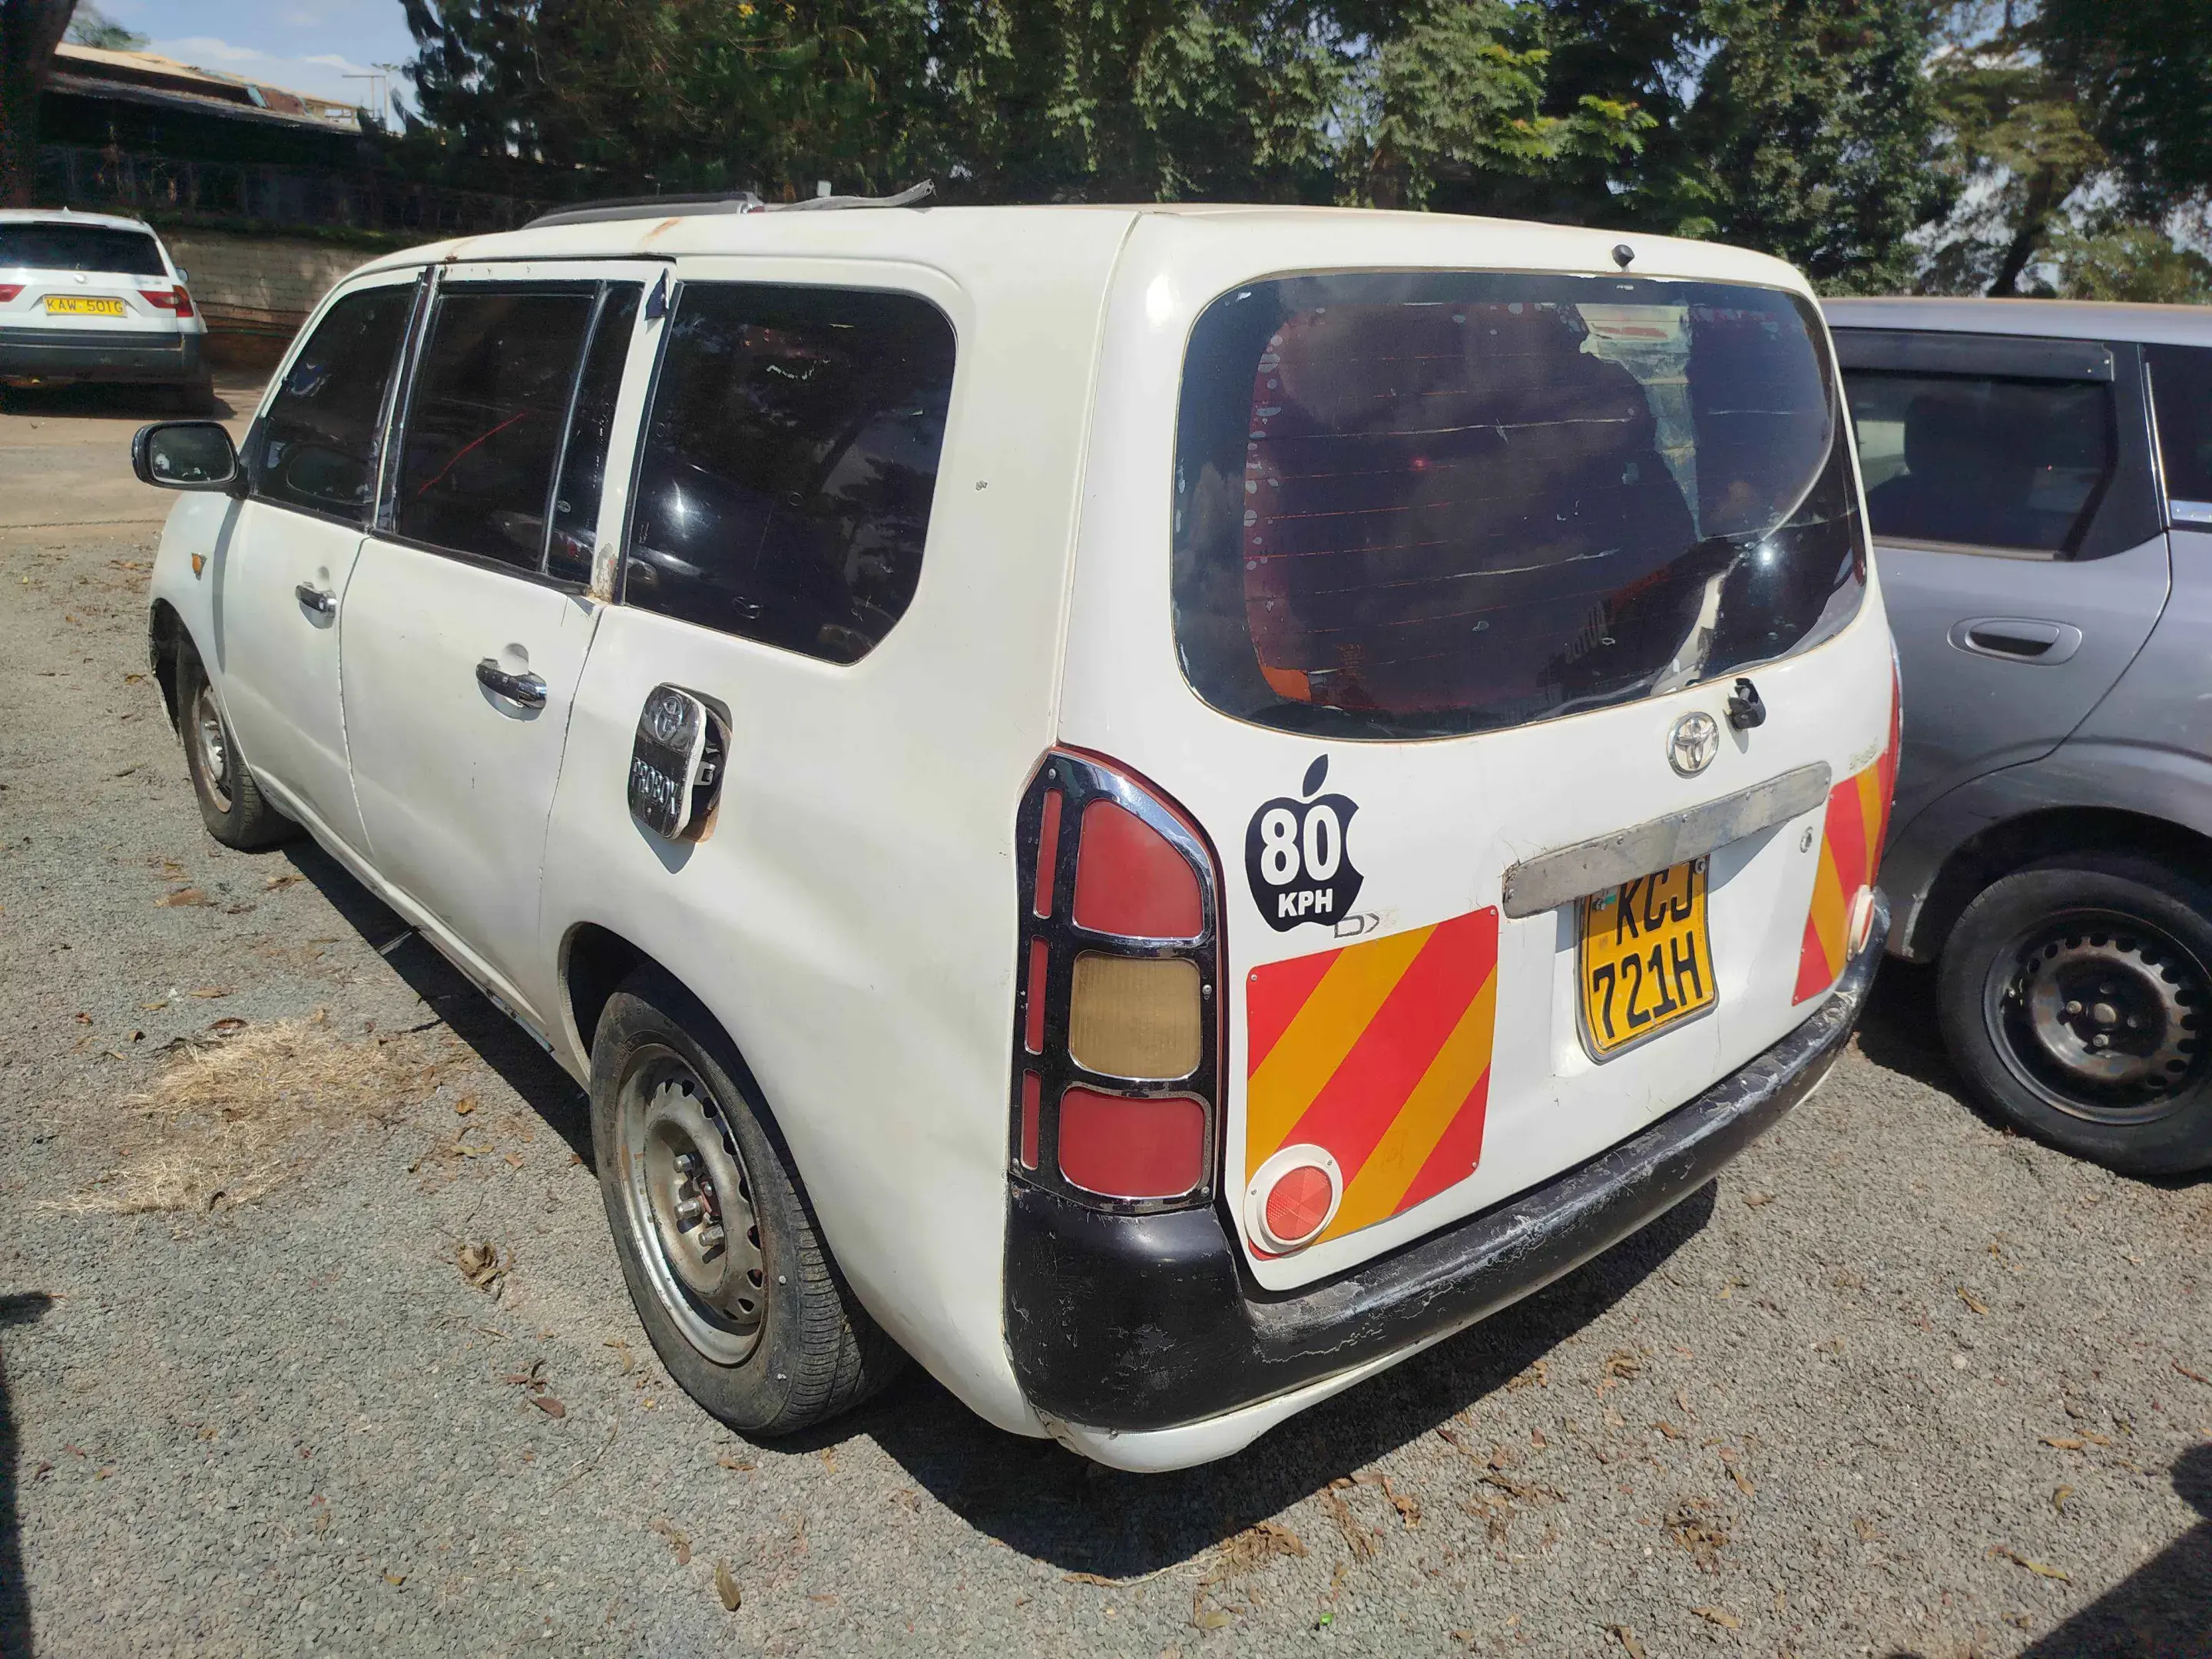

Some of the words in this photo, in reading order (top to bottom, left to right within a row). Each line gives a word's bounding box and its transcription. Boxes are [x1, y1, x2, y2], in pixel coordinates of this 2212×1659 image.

[46, 298, 77, 311] KAW
[87, 299, 124, 313] 501G
[631, 756, 679, 816] PROBOX
[1260, 804, 1342, 886] 80
[1277, 888, 1333, 919] KPH
[1616, 861, 1694, 946] KCJ
[1592, 929, 1704, 1040] 721H
